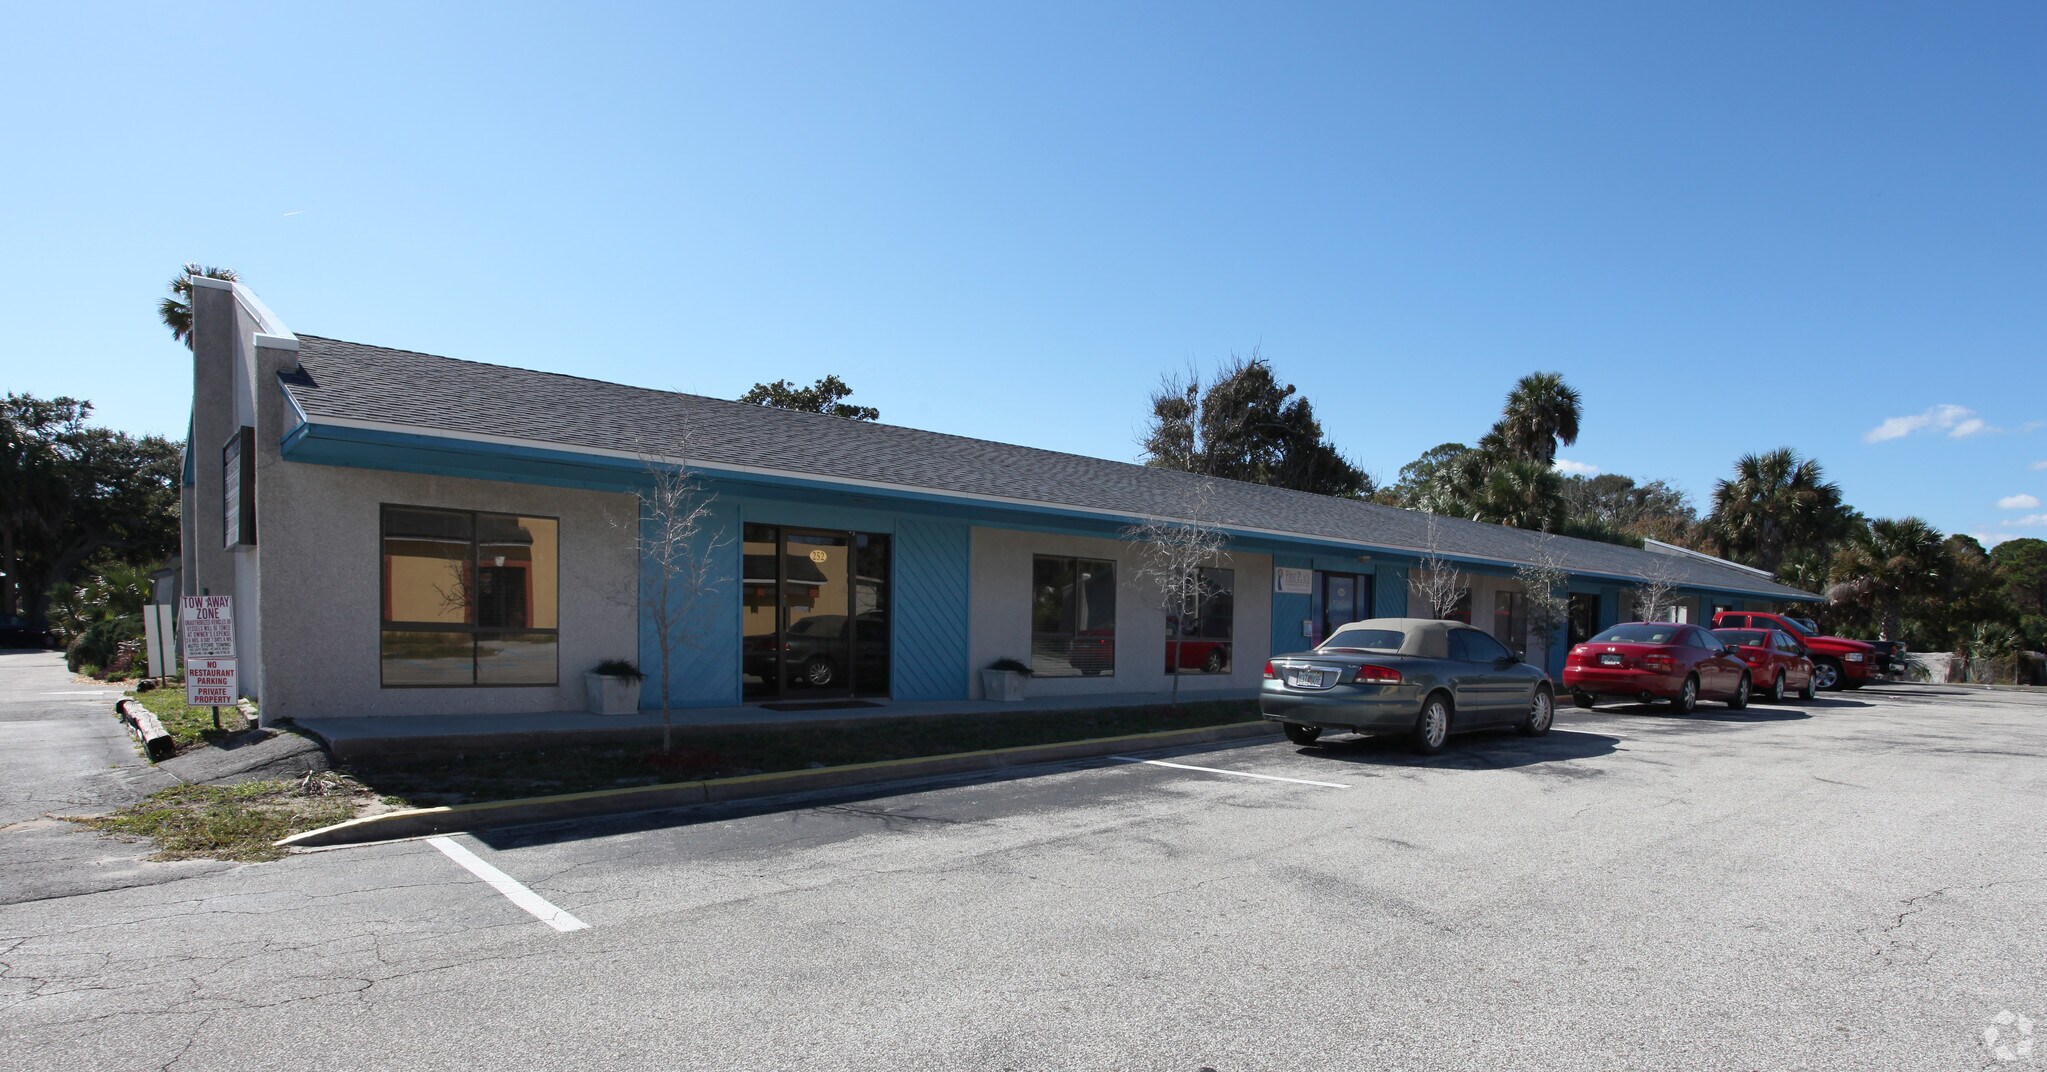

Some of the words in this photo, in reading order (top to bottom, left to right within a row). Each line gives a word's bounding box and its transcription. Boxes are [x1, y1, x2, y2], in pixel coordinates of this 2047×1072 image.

[812, 552, 824, 560] 252
[183, 598, 203, 608] TOW
[207, 597, 229, 607] AWAY
[197, 608, 220, 619] ZONE
